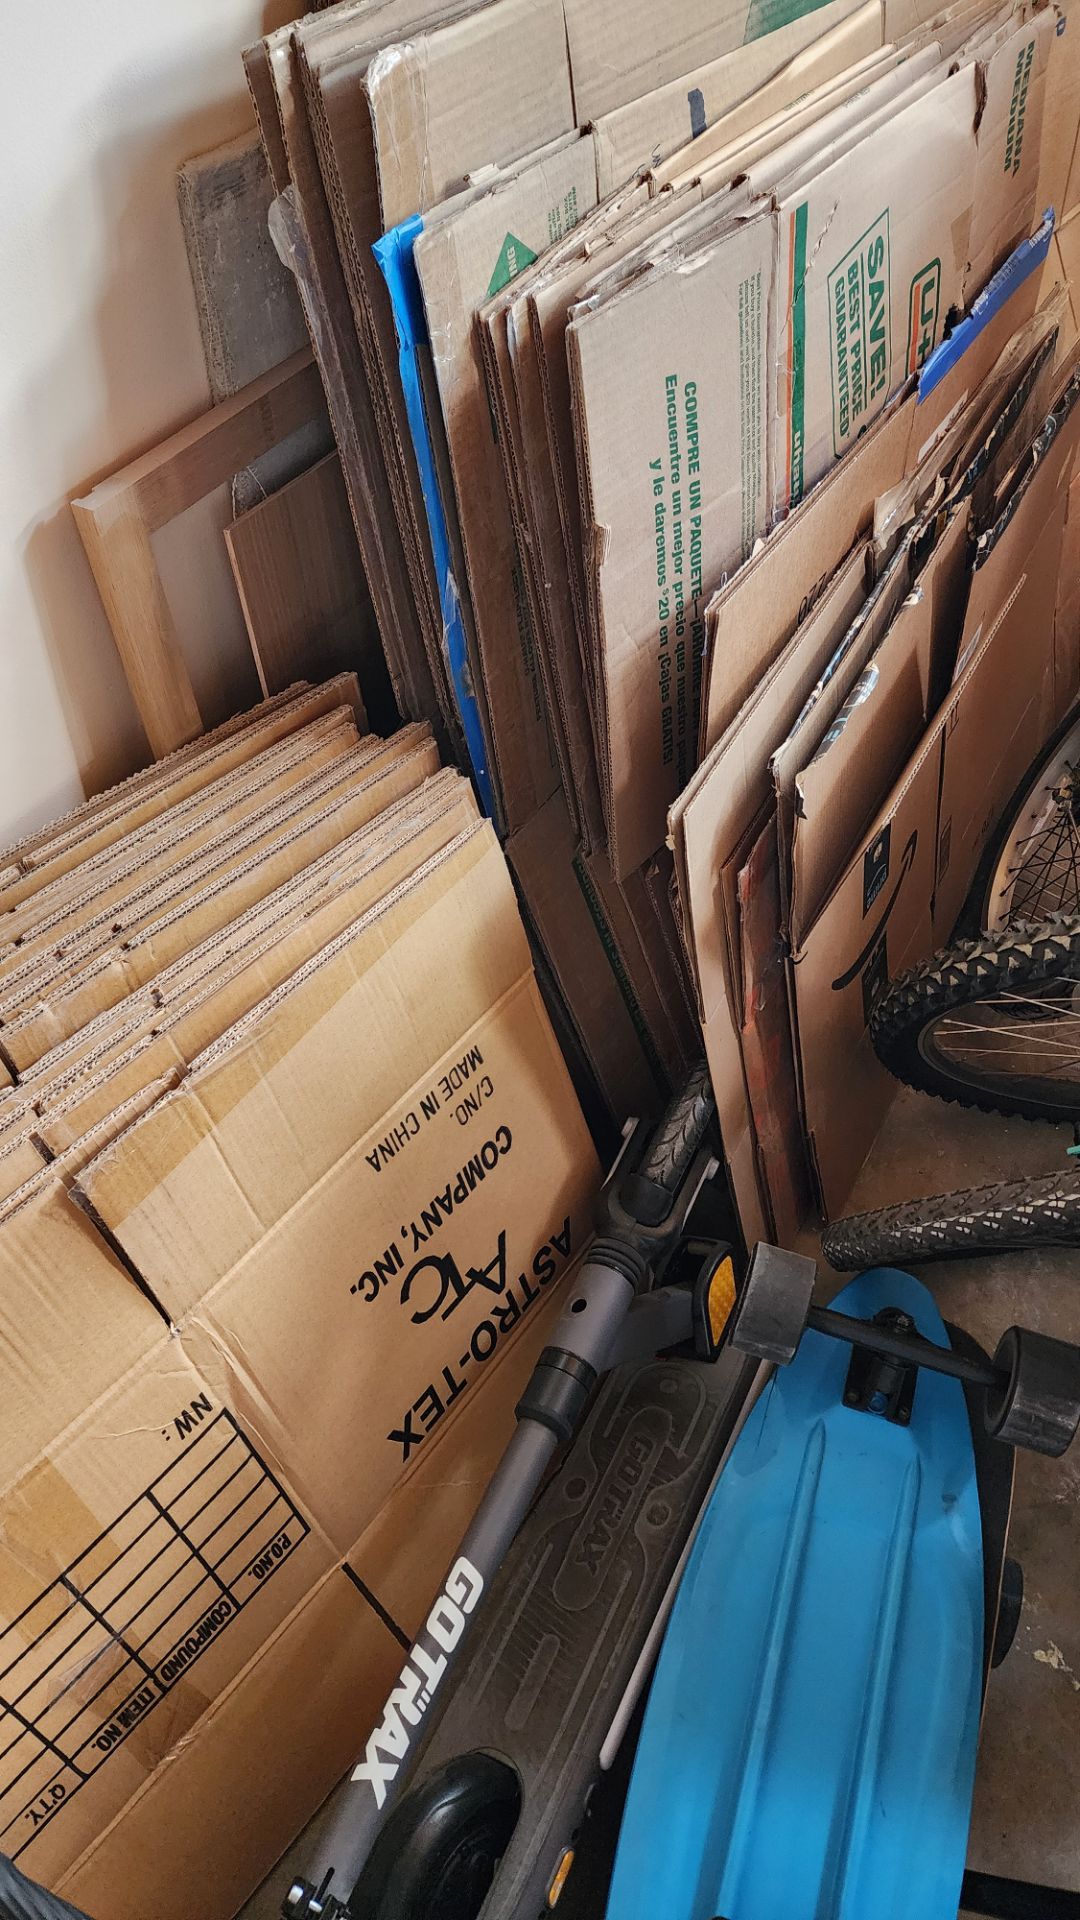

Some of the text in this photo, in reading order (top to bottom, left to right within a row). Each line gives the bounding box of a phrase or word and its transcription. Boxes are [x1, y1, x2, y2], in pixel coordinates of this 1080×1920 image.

[1004, 48, 1026, 172] MEDIUM
[1012, 40, 1035, 178] MEDIANA
[848, 259, 863, 421] BEST PRICE
[867, 235, 887, 401] SAVE!
[665, 374, 682, 484] Encuentre
[684, 381, 700, 475] COMPRE
[649, 457, 662, 471] y
[653, 476, 665, 497] le
[688, 479, 702, 510] UN
[671, 489, 681, 516] un
[654, 502, 667, 587] daremos
[672, 521, 685, 574] mejor
[659, 625, 669, 647] en
[672, 580, 687, 637] precio
[657, 652, 672, 702] ¡Cajas
[674, 640, 686, 673] que
[661, 705, 673, 767] GRATIS!
[677, 674, 686, 736] nuestro
[364, 1045, 485, 1172] MADE IN CHINA
[450, 1075, 495, 1126] C/NO.
[349, 1125, 513, 1303] COMPANY, INC.
[386, 1215, 572, 1464] ASTRO-TEX
[160, 1600, 233, 1683] COMPOUND
[350, 1555, 485, 1810] GOTRAX
[91, 1686, 156, 1753] ITEM NO.
